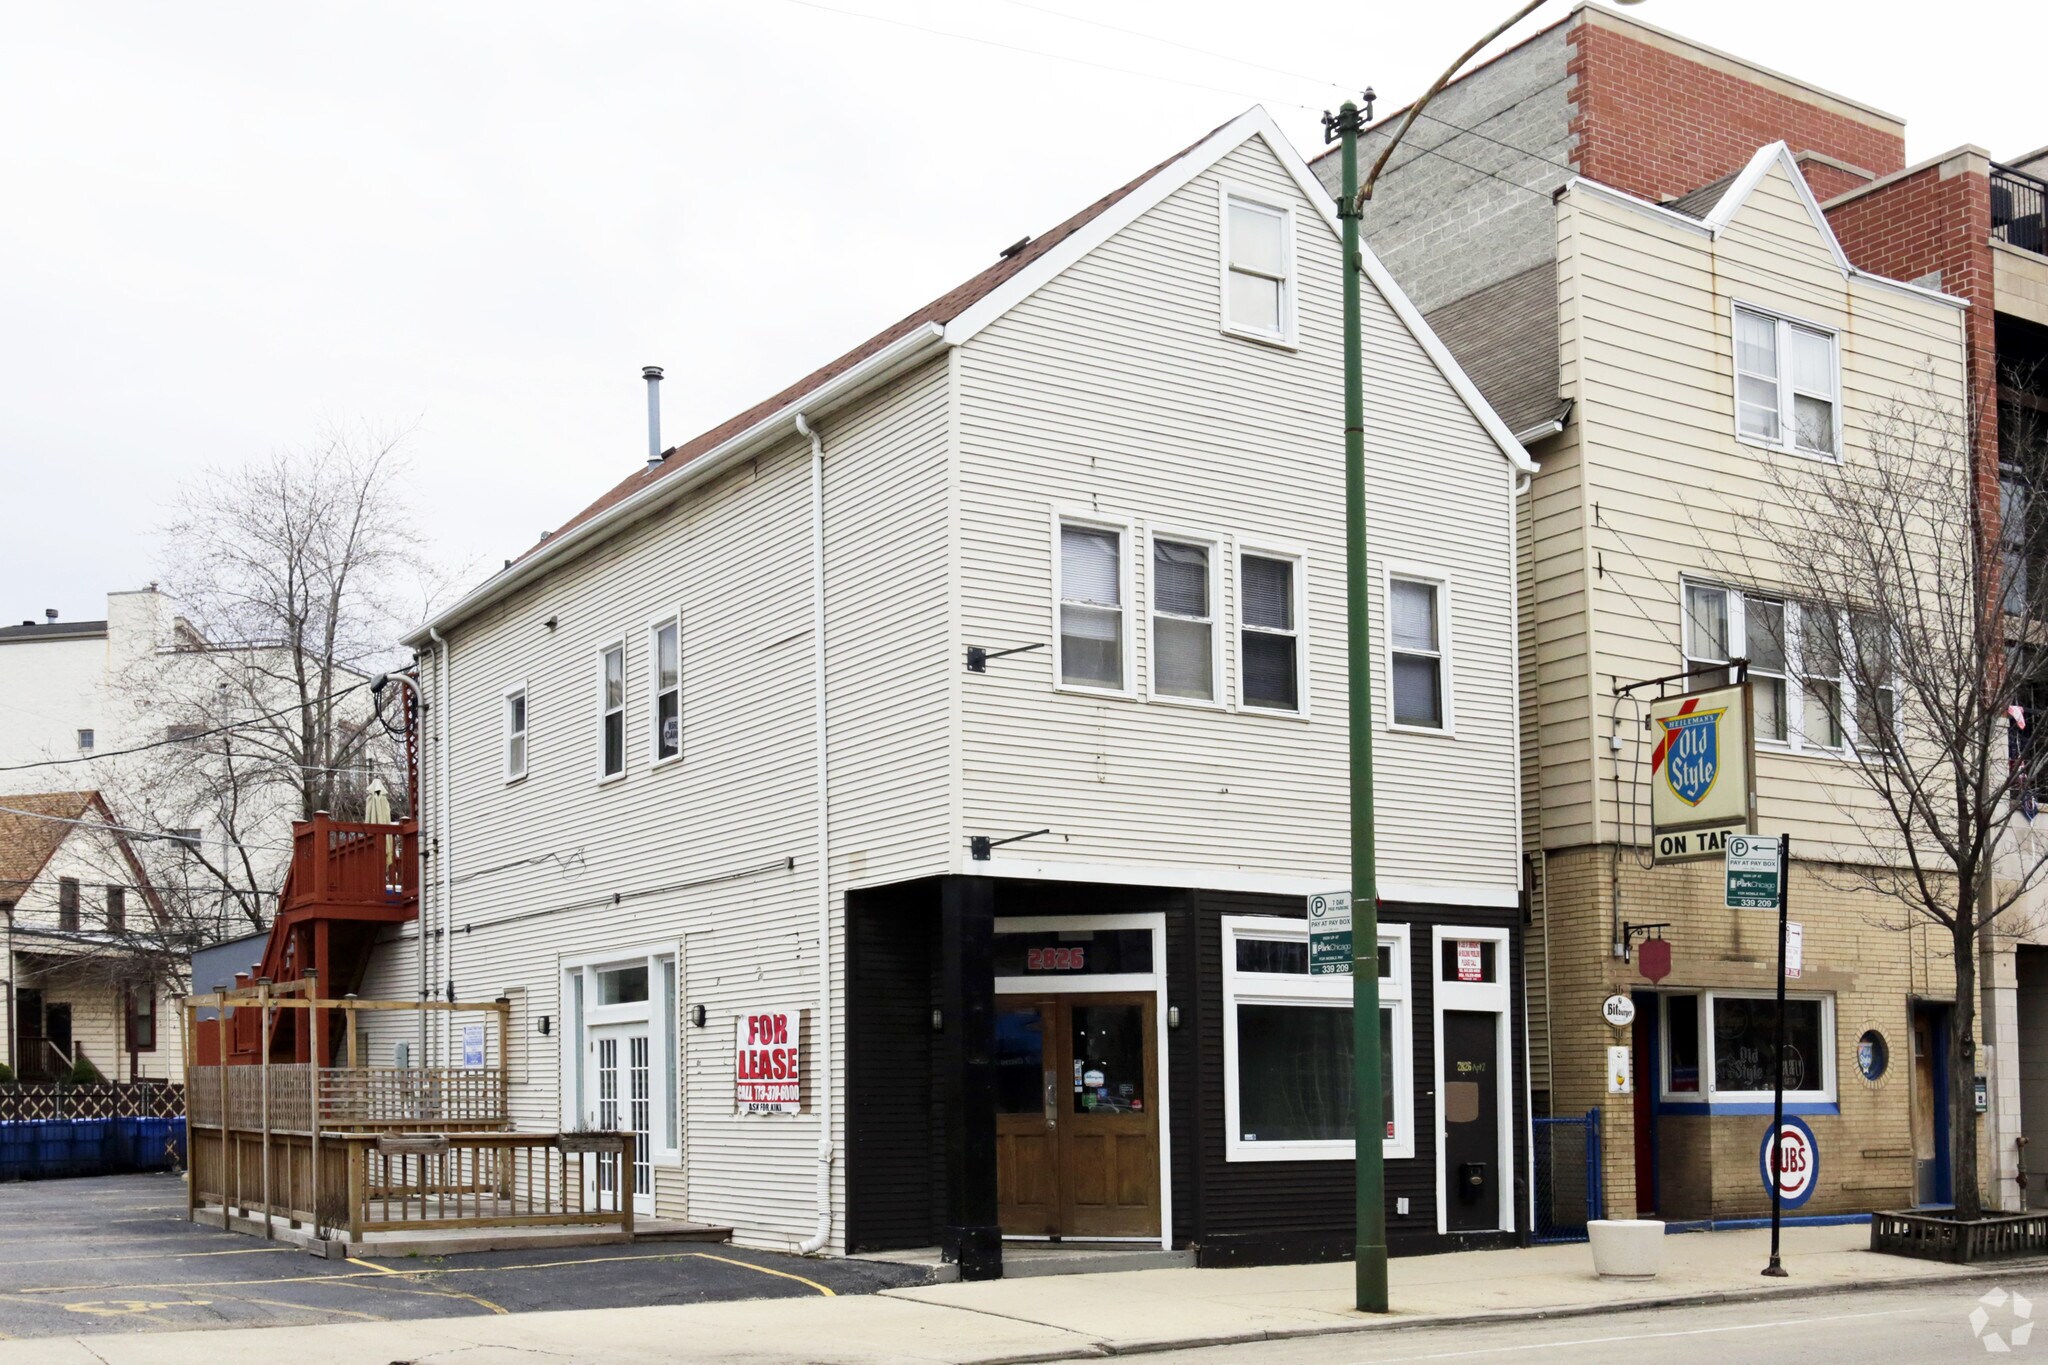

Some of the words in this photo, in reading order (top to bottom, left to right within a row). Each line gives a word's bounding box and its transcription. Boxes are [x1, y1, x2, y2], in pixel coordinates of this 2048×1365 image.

[1680, 726, 1707, 759] Old
[1672, 756, 1714, 797] Style
[1660, 836, 1686, 855] ON
[1028, 948, 1084, 969] 2826
[1322, 965, 1335, 973] 339
[1336, 964, 1349, 972] 209
[748, 1014, 788, 1045] FOR
[738, 1048, 798, 1079] LEASE
[738, 1085, 753, 1100] CALL
